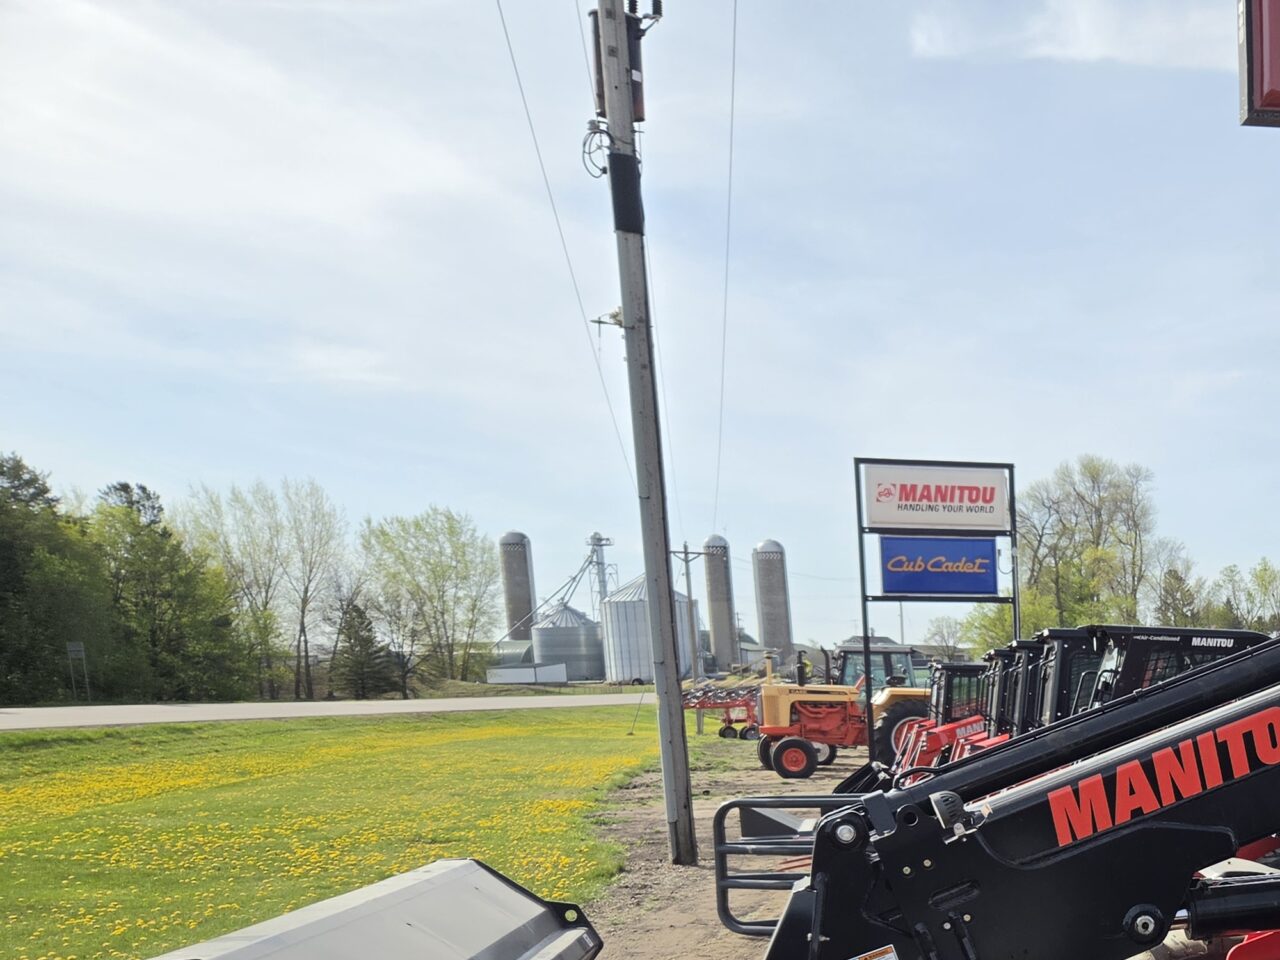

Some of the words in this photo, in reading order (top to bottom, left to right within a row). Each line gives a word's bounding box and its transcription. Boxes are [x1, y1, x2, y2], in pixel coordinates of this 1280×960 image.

[898, 484, 996, 504] MANITOU
[897, 504, 940, 512] HANDLING
[942, 504, 964, 513] YOUR
[965, 505, 995, 514] WORLD
[887, 555, 925, 572] Cub
[927, 556, 990, 573] Cadet
[1191, 637, 1235, 648] MANITOU
